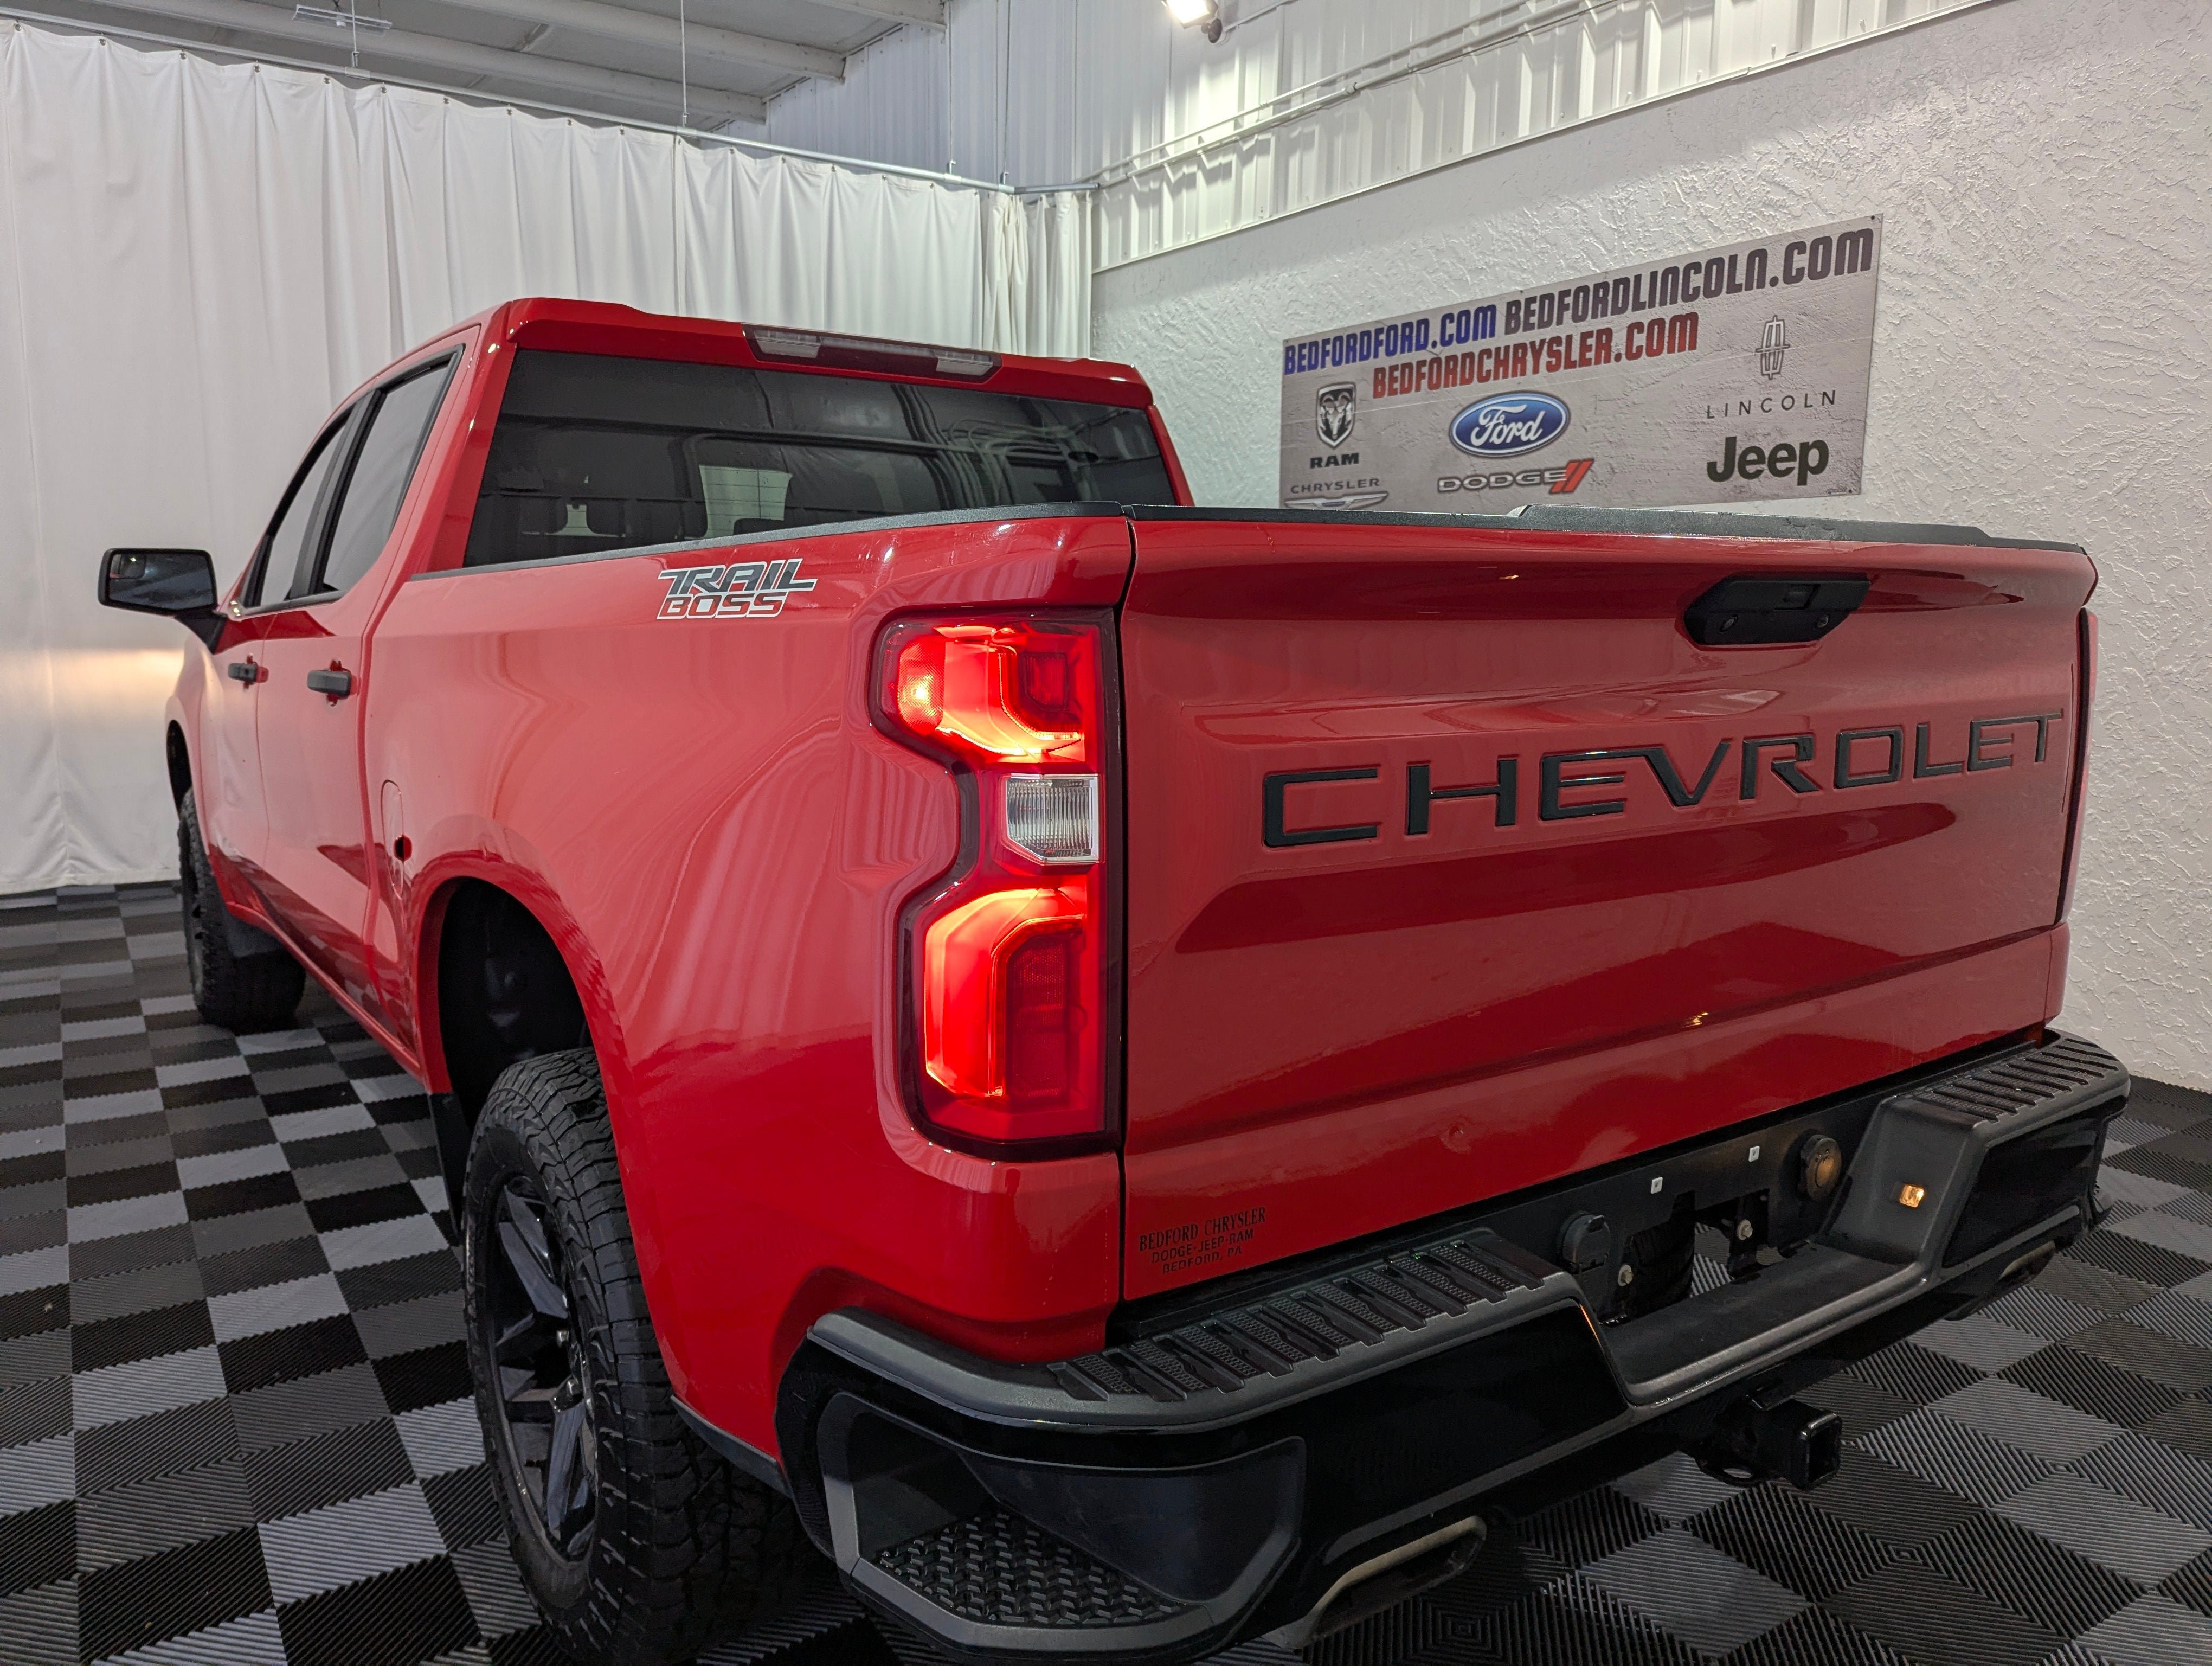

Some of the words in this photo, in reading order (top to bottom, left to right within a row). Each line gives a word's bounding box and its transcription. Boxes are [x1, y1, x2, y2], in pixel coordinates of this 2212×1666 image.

[1284, 304, 1497, 375] BEDFORDFORD.COM
[1504, 228, 1874, 335] BEDFORDLINCOLN.COM
[1372, 312, 1699, 399] BEDFORDCHRYSLER.COM
[1707, 389, 1836, 419] LINCOLN
[1470, 404, 1546, 446] Ford
[1309, 452, 1359, 469] RAM
[1707, 436, 1829, 486] Jeep
[1290, 478, 1380, 494] CHRYSLER
[1438, 467, 1568, 492] DODGE
[657, 558, 818, 595] TRAIL
[657, 591, 789, 619] BOSS
[1263, 712, 2063, 848] CHEVROLET
[1139, 1223, 1198, 1252] BEDFORD
[1204, 1207, 1266, 1235] CHRYSLER
[1162, 1252, 1223, 1274] BEDFORD,
[1227, 1246, 1243, 1258] PA
